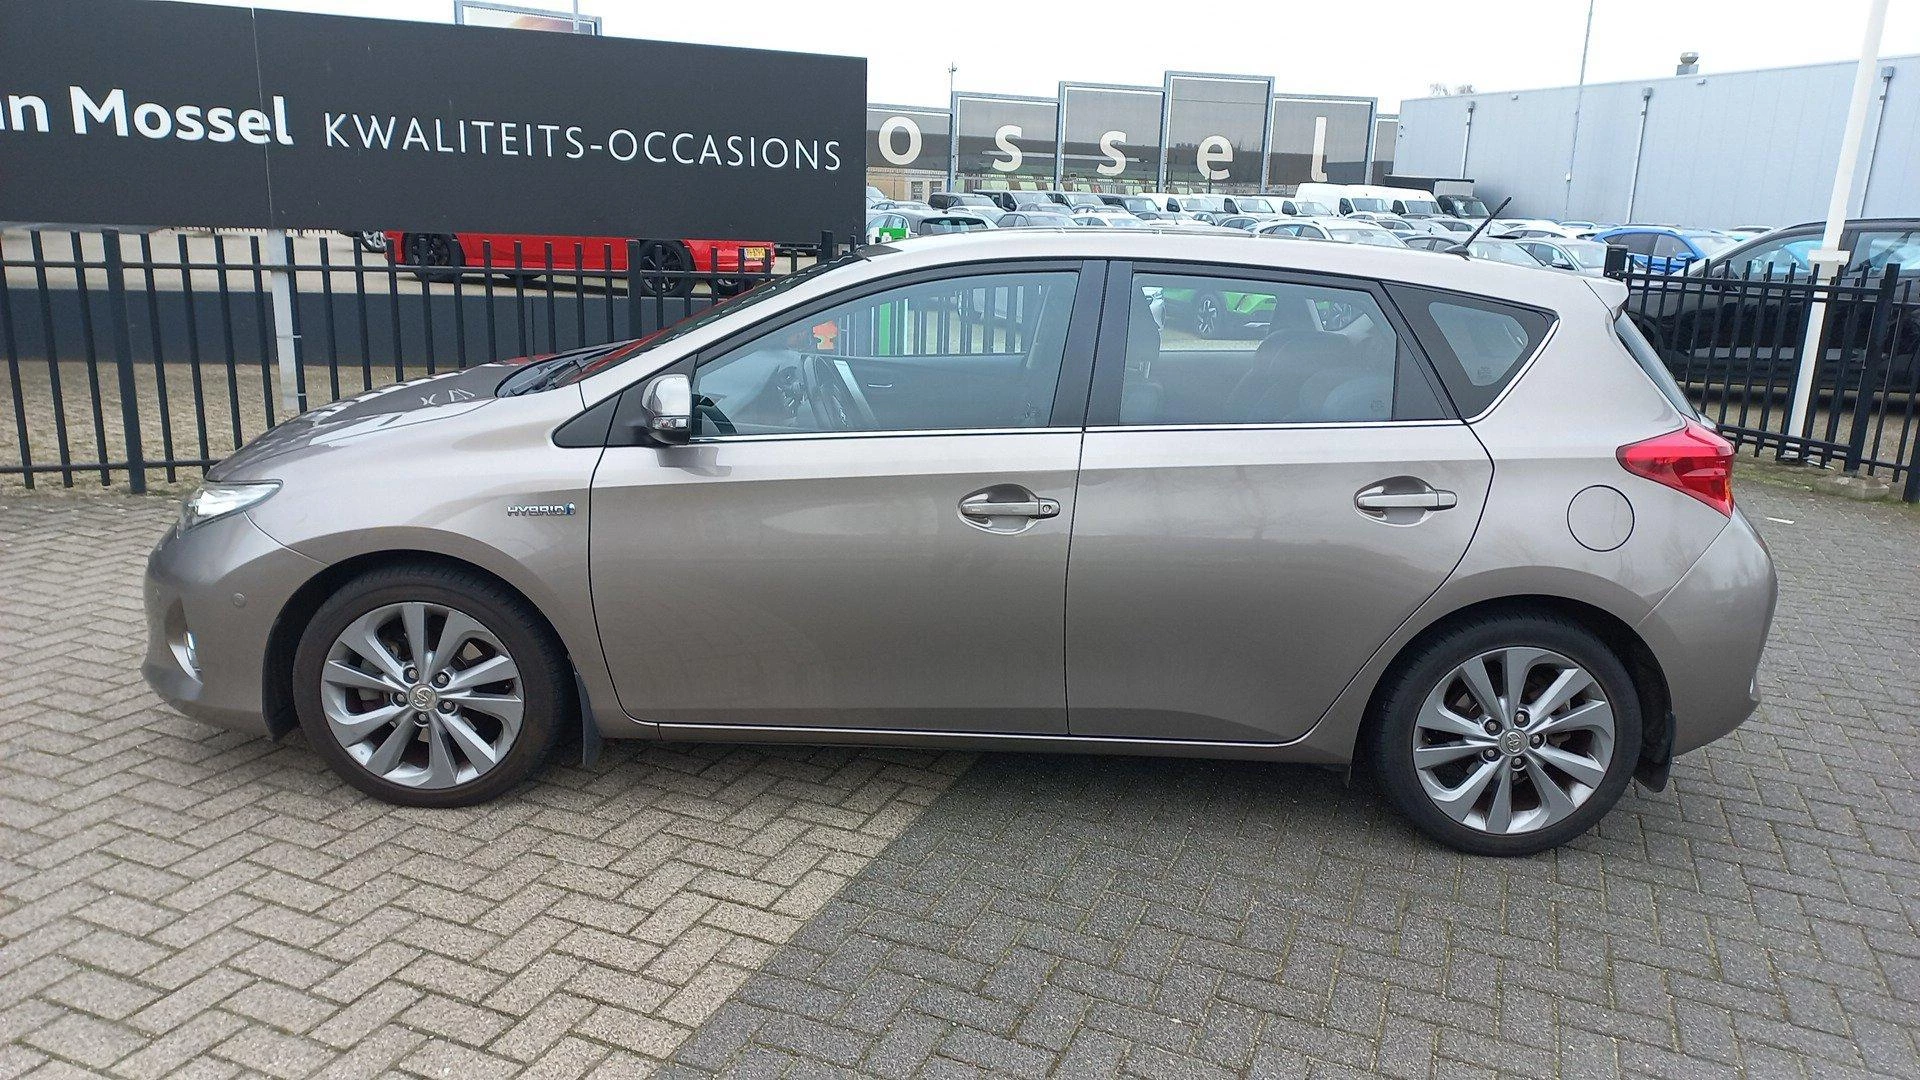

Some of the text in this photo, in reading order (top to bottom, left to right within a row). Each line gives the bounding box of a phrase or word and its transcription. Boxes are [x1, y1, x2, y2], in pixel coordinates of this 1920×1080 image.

[0, 85, 841, 171] n Mossel KWALITEITS-OCCASIONS
[507, 505, 566, 517] HYBRID
